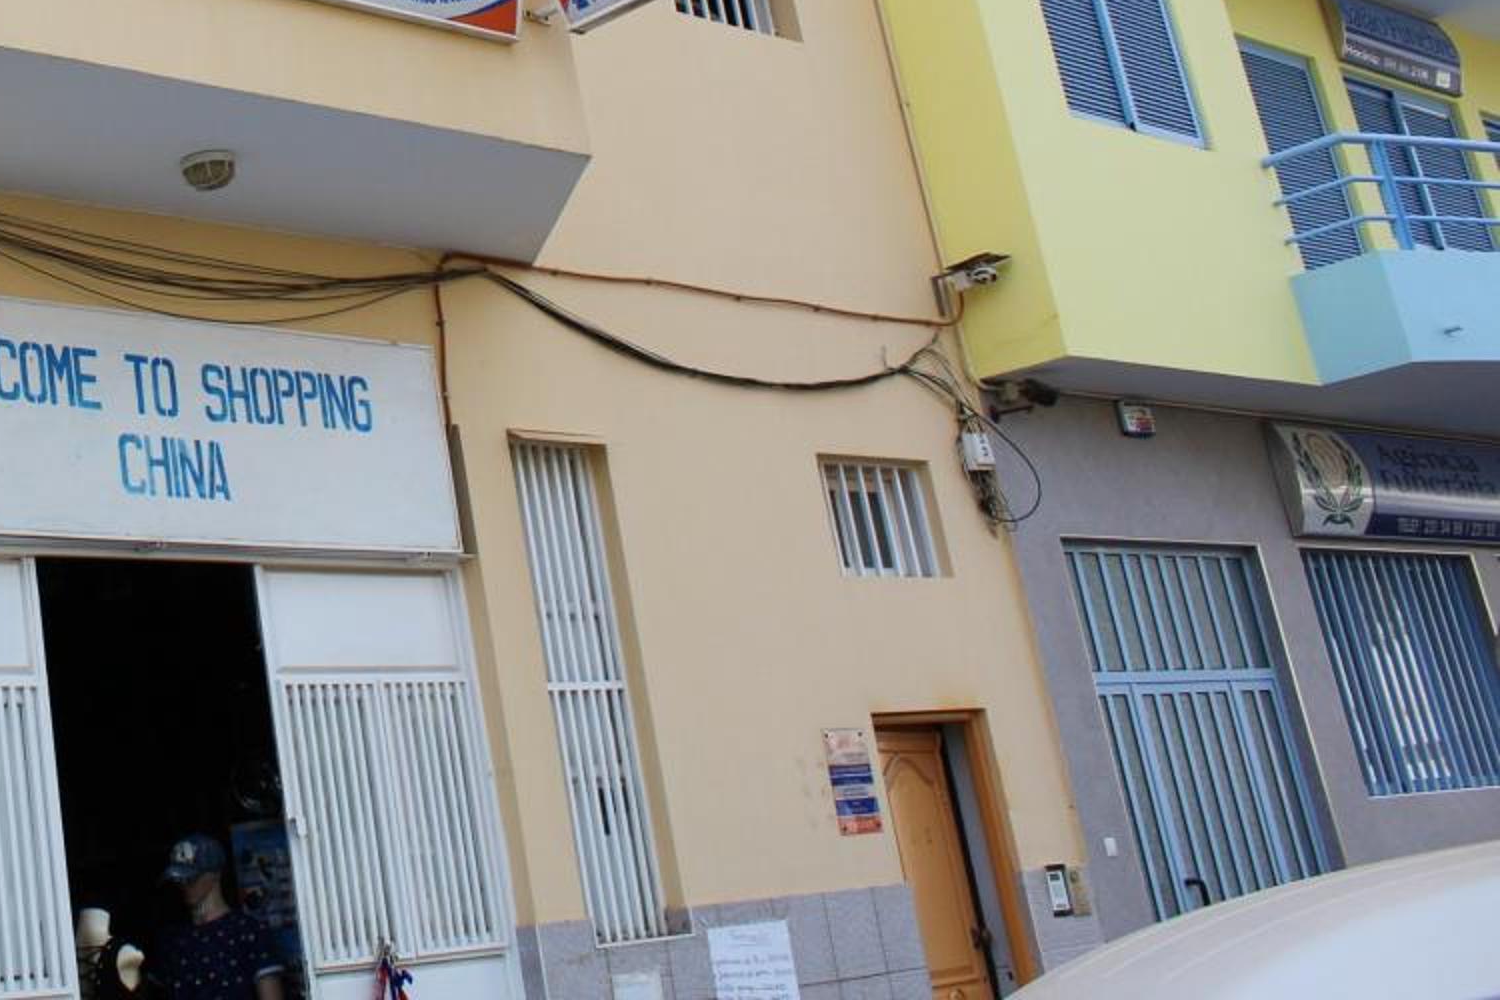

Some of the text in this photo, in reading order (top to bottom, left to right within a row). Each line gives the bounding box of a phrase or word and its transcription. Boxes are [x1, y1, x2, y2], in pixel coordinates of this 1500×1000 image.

[123, 353, 180, 418] TO
[200, 363, 373, 433] SHOPPING
[116, 432, 231, 501] CHINA
